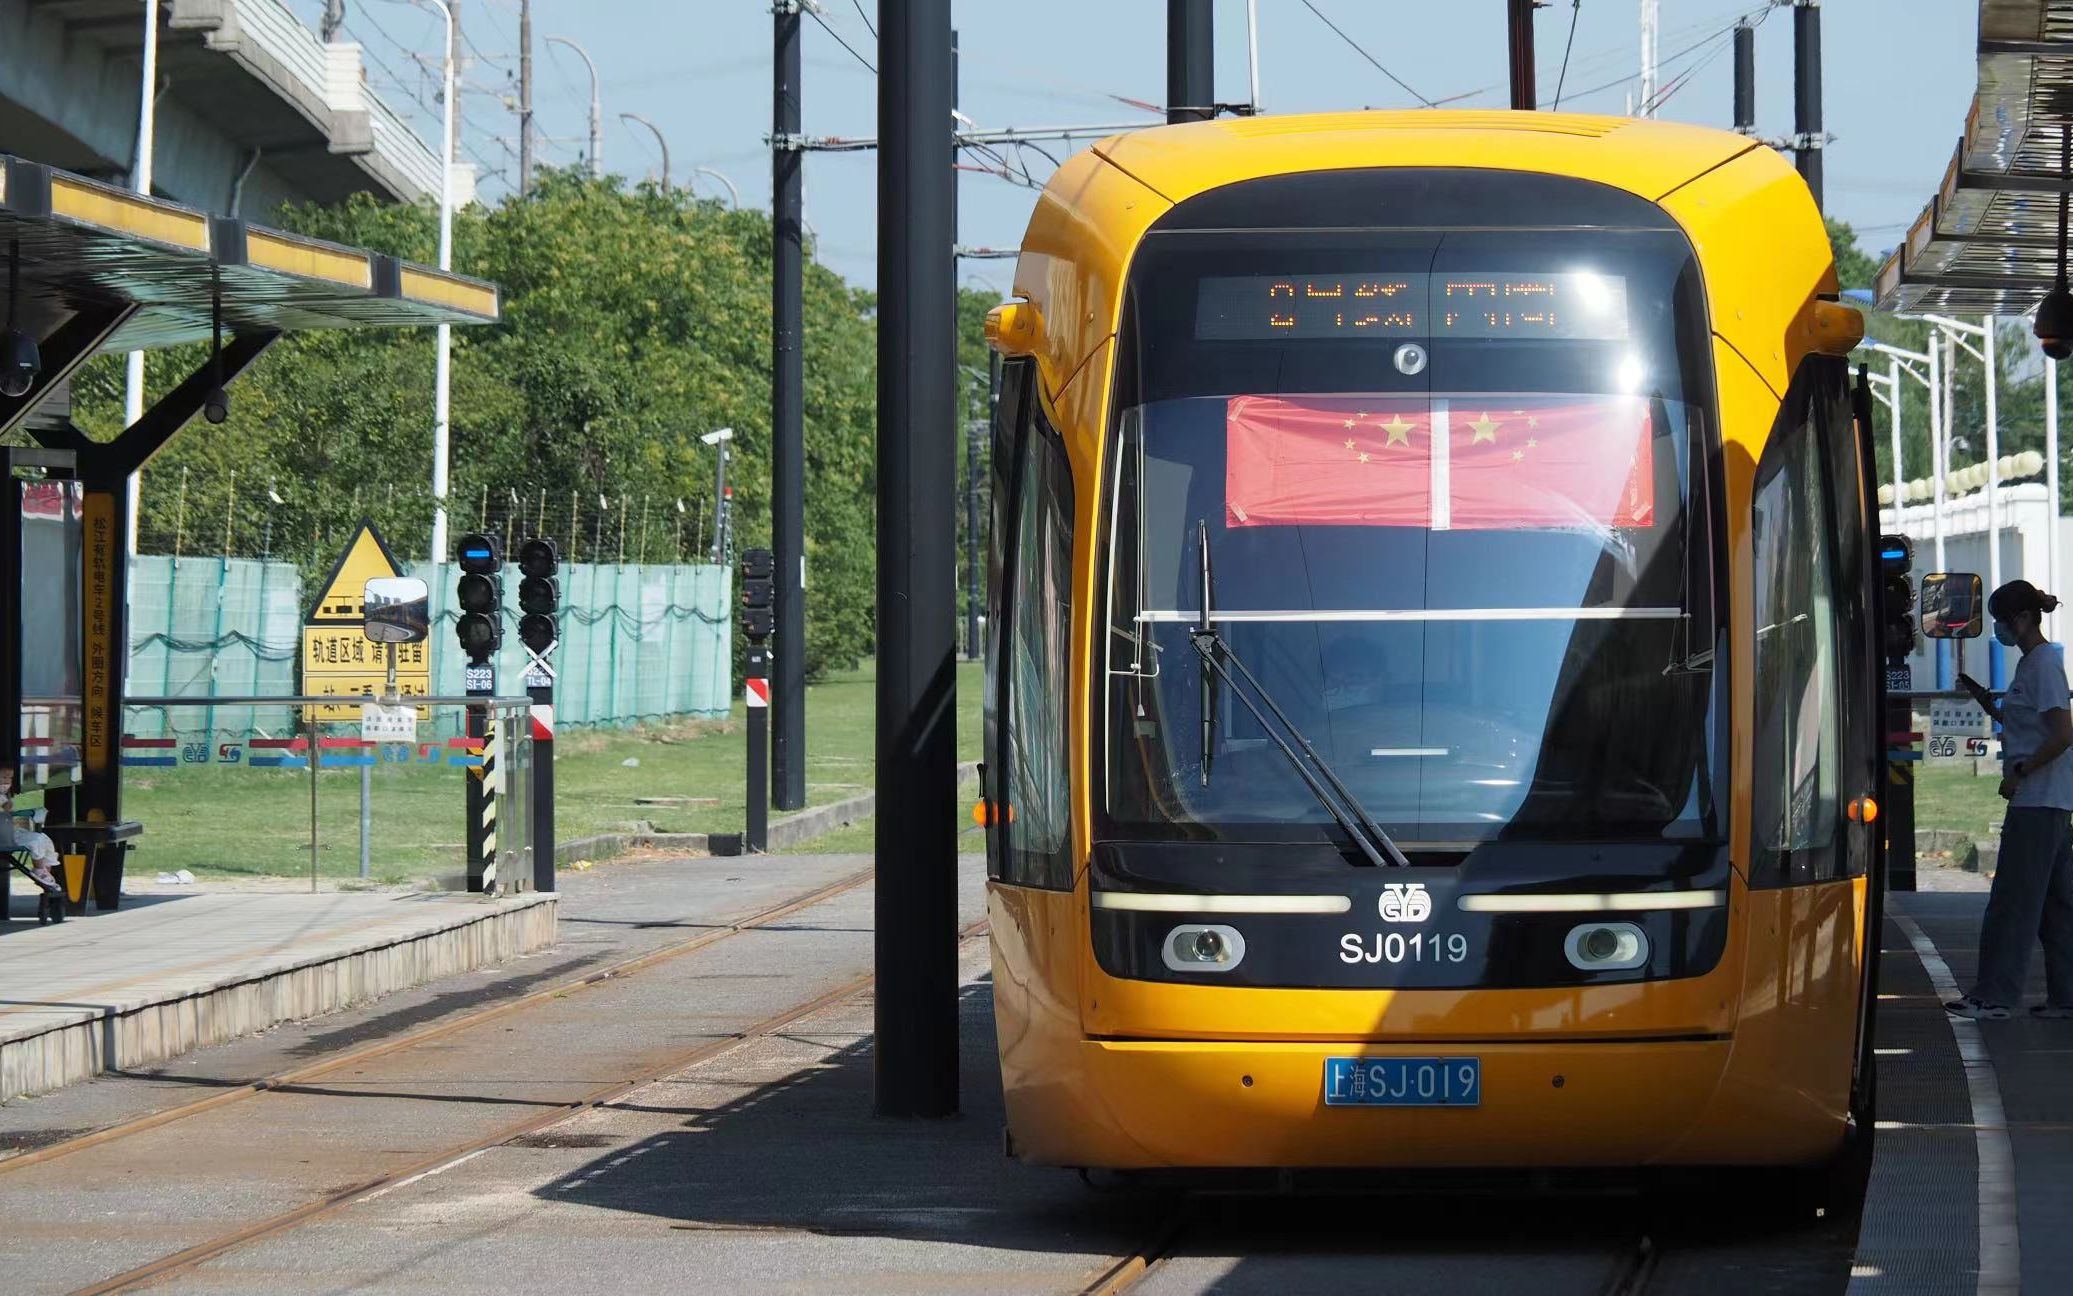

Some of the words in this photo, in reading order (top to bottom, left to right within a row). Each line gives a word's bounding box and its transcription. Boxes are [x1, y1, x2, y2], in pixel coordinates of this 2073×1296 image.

[312, 635, 365, 664] 轨道区域
[371, 638, 423, 664] 请驻留
[466, 668, 492, 679] S223
[466, 679, 492, 690] SI-06
[1340, 932, 1467, 964] SJ0119
